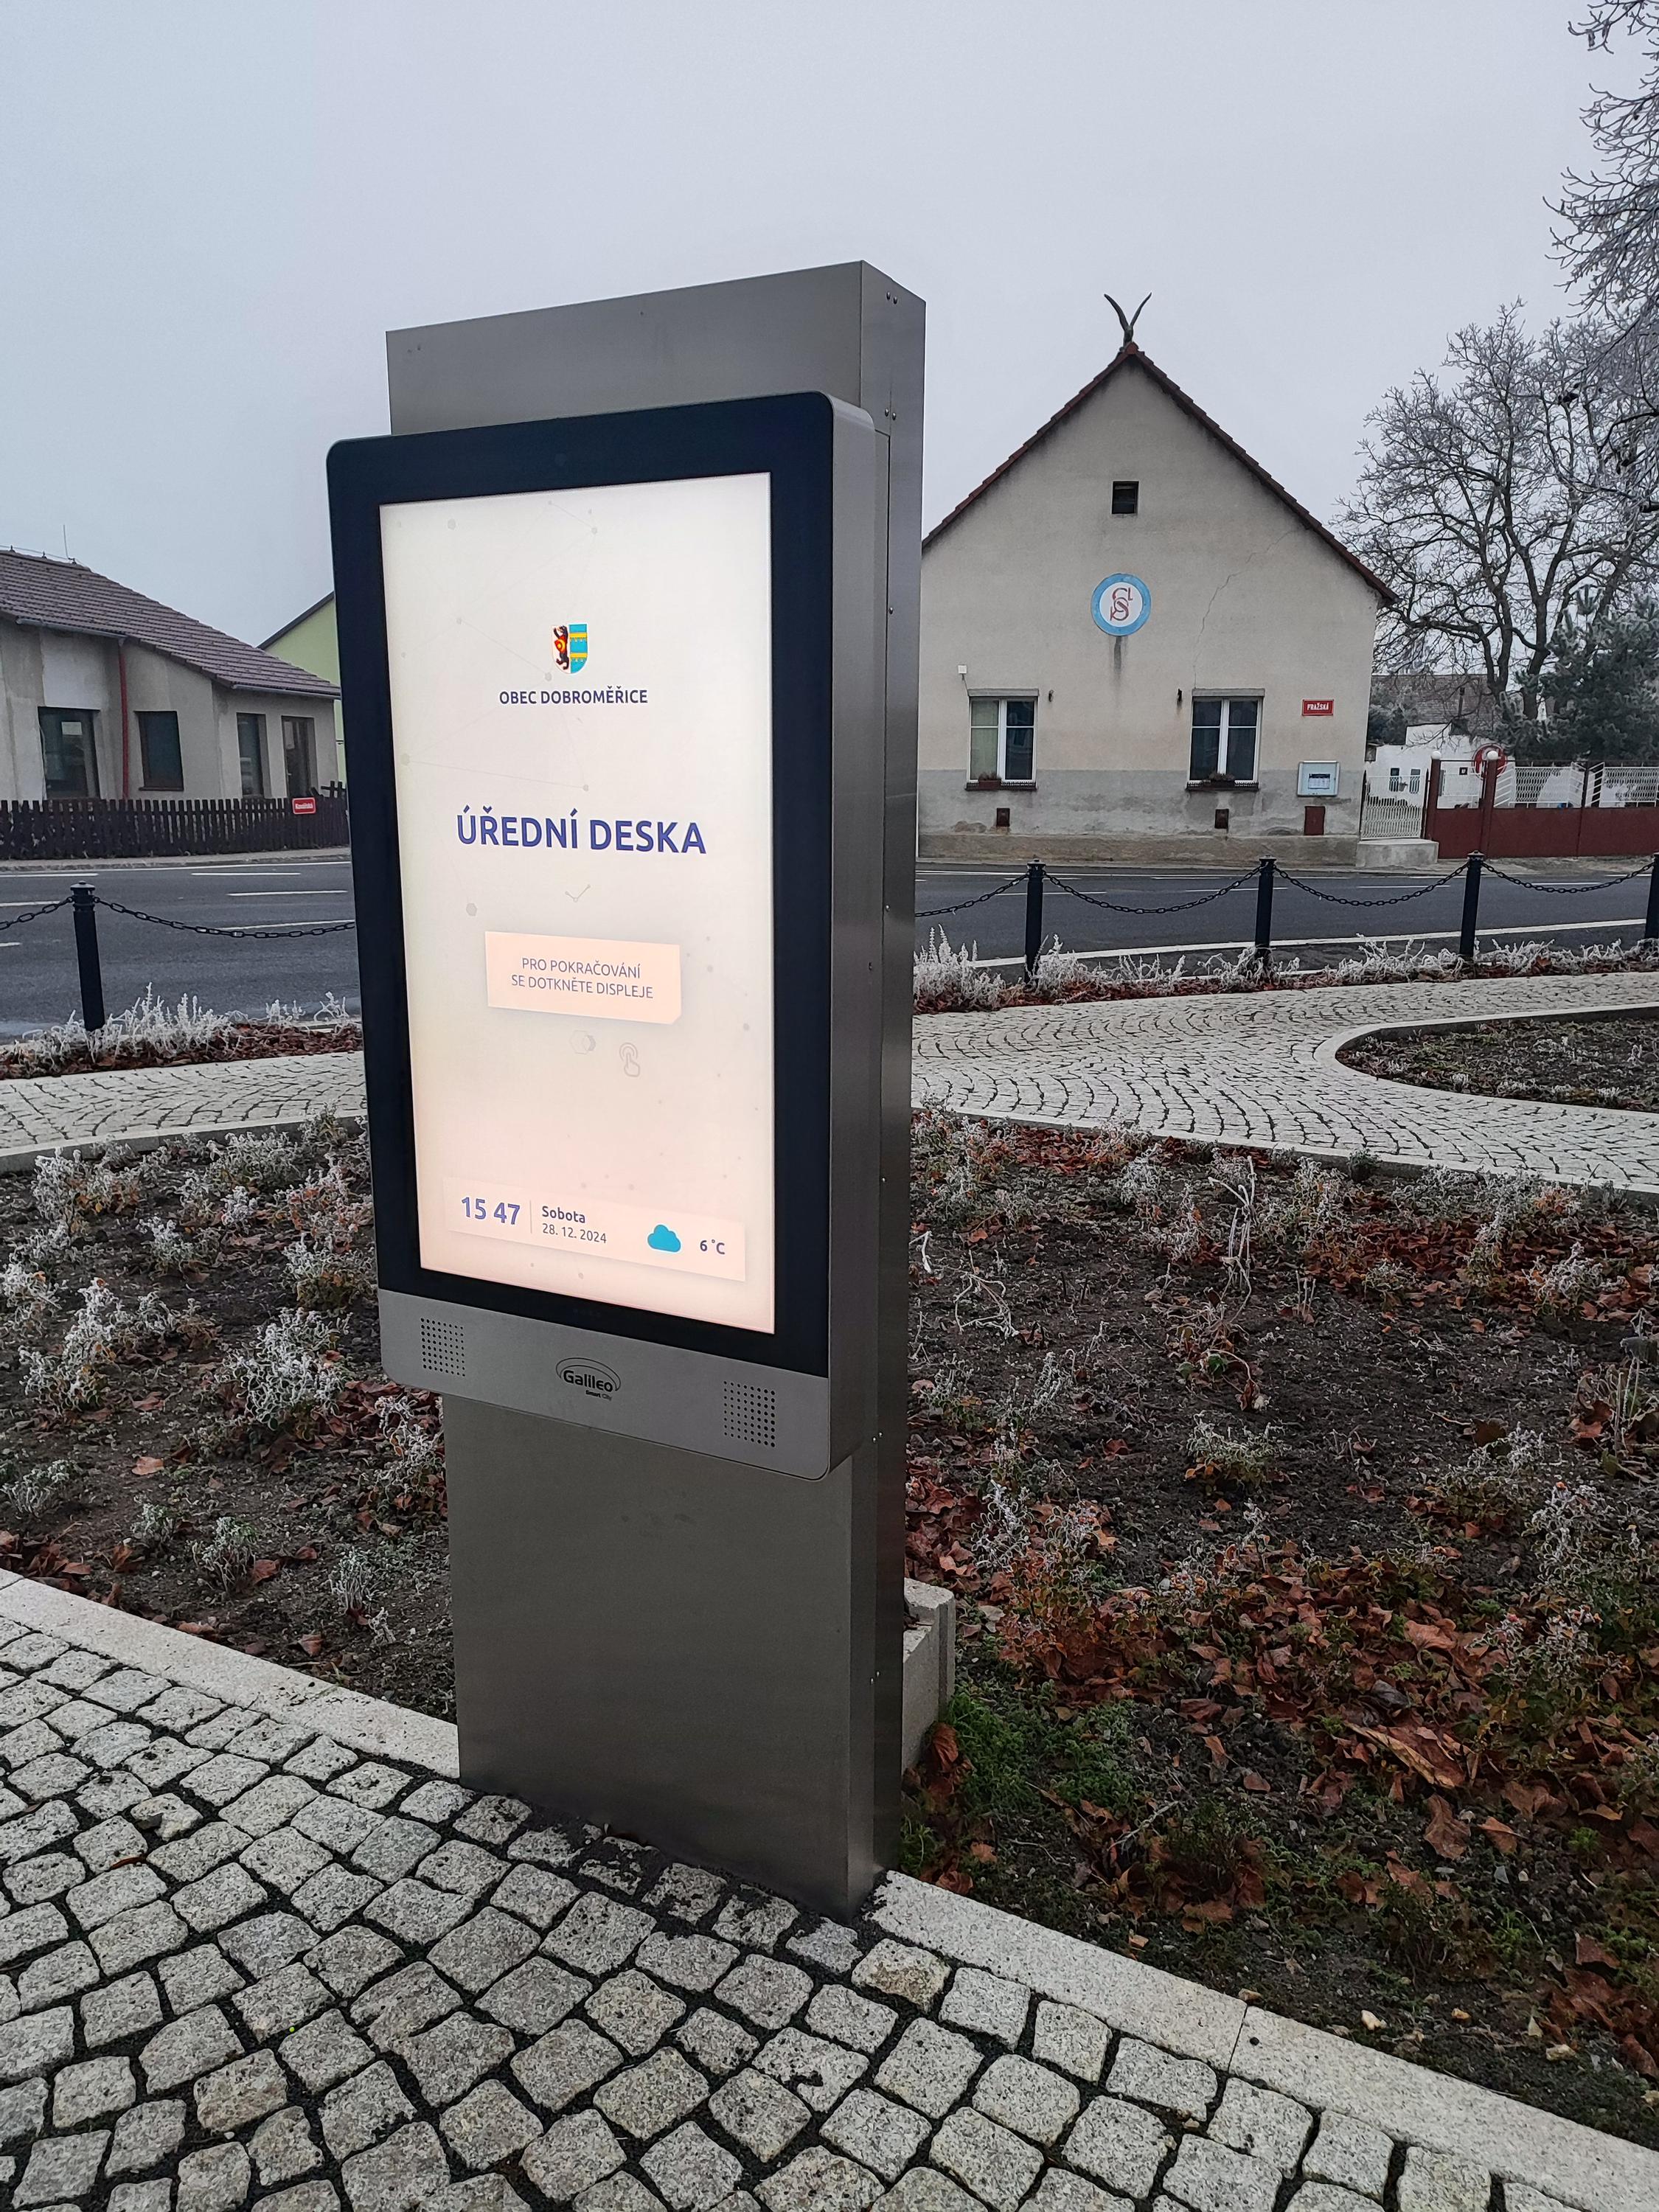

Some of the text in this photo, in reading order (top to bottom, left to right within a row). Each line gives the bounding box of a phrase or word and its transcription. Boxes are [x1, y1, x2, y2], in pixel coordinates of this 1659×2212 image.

[499, 686, 648, 704] OBEC DOBROMĚŘICE
[1307, 702, 1329, 711] PRAŽSKÁ
[456, 805, 706, 854] ÚŘEDNÍ DESKA
[522, 958, 641, 979] PRO POKRAČOVÁNÍ
[512, 975, 653, 999] SE DOTKNĚTE DISPLEJE
[462, 1197, 521, 1225] 15 47
[542, 1206, 586, 1223] Sobota
[563, 1370, 613, 1393] Galileo
